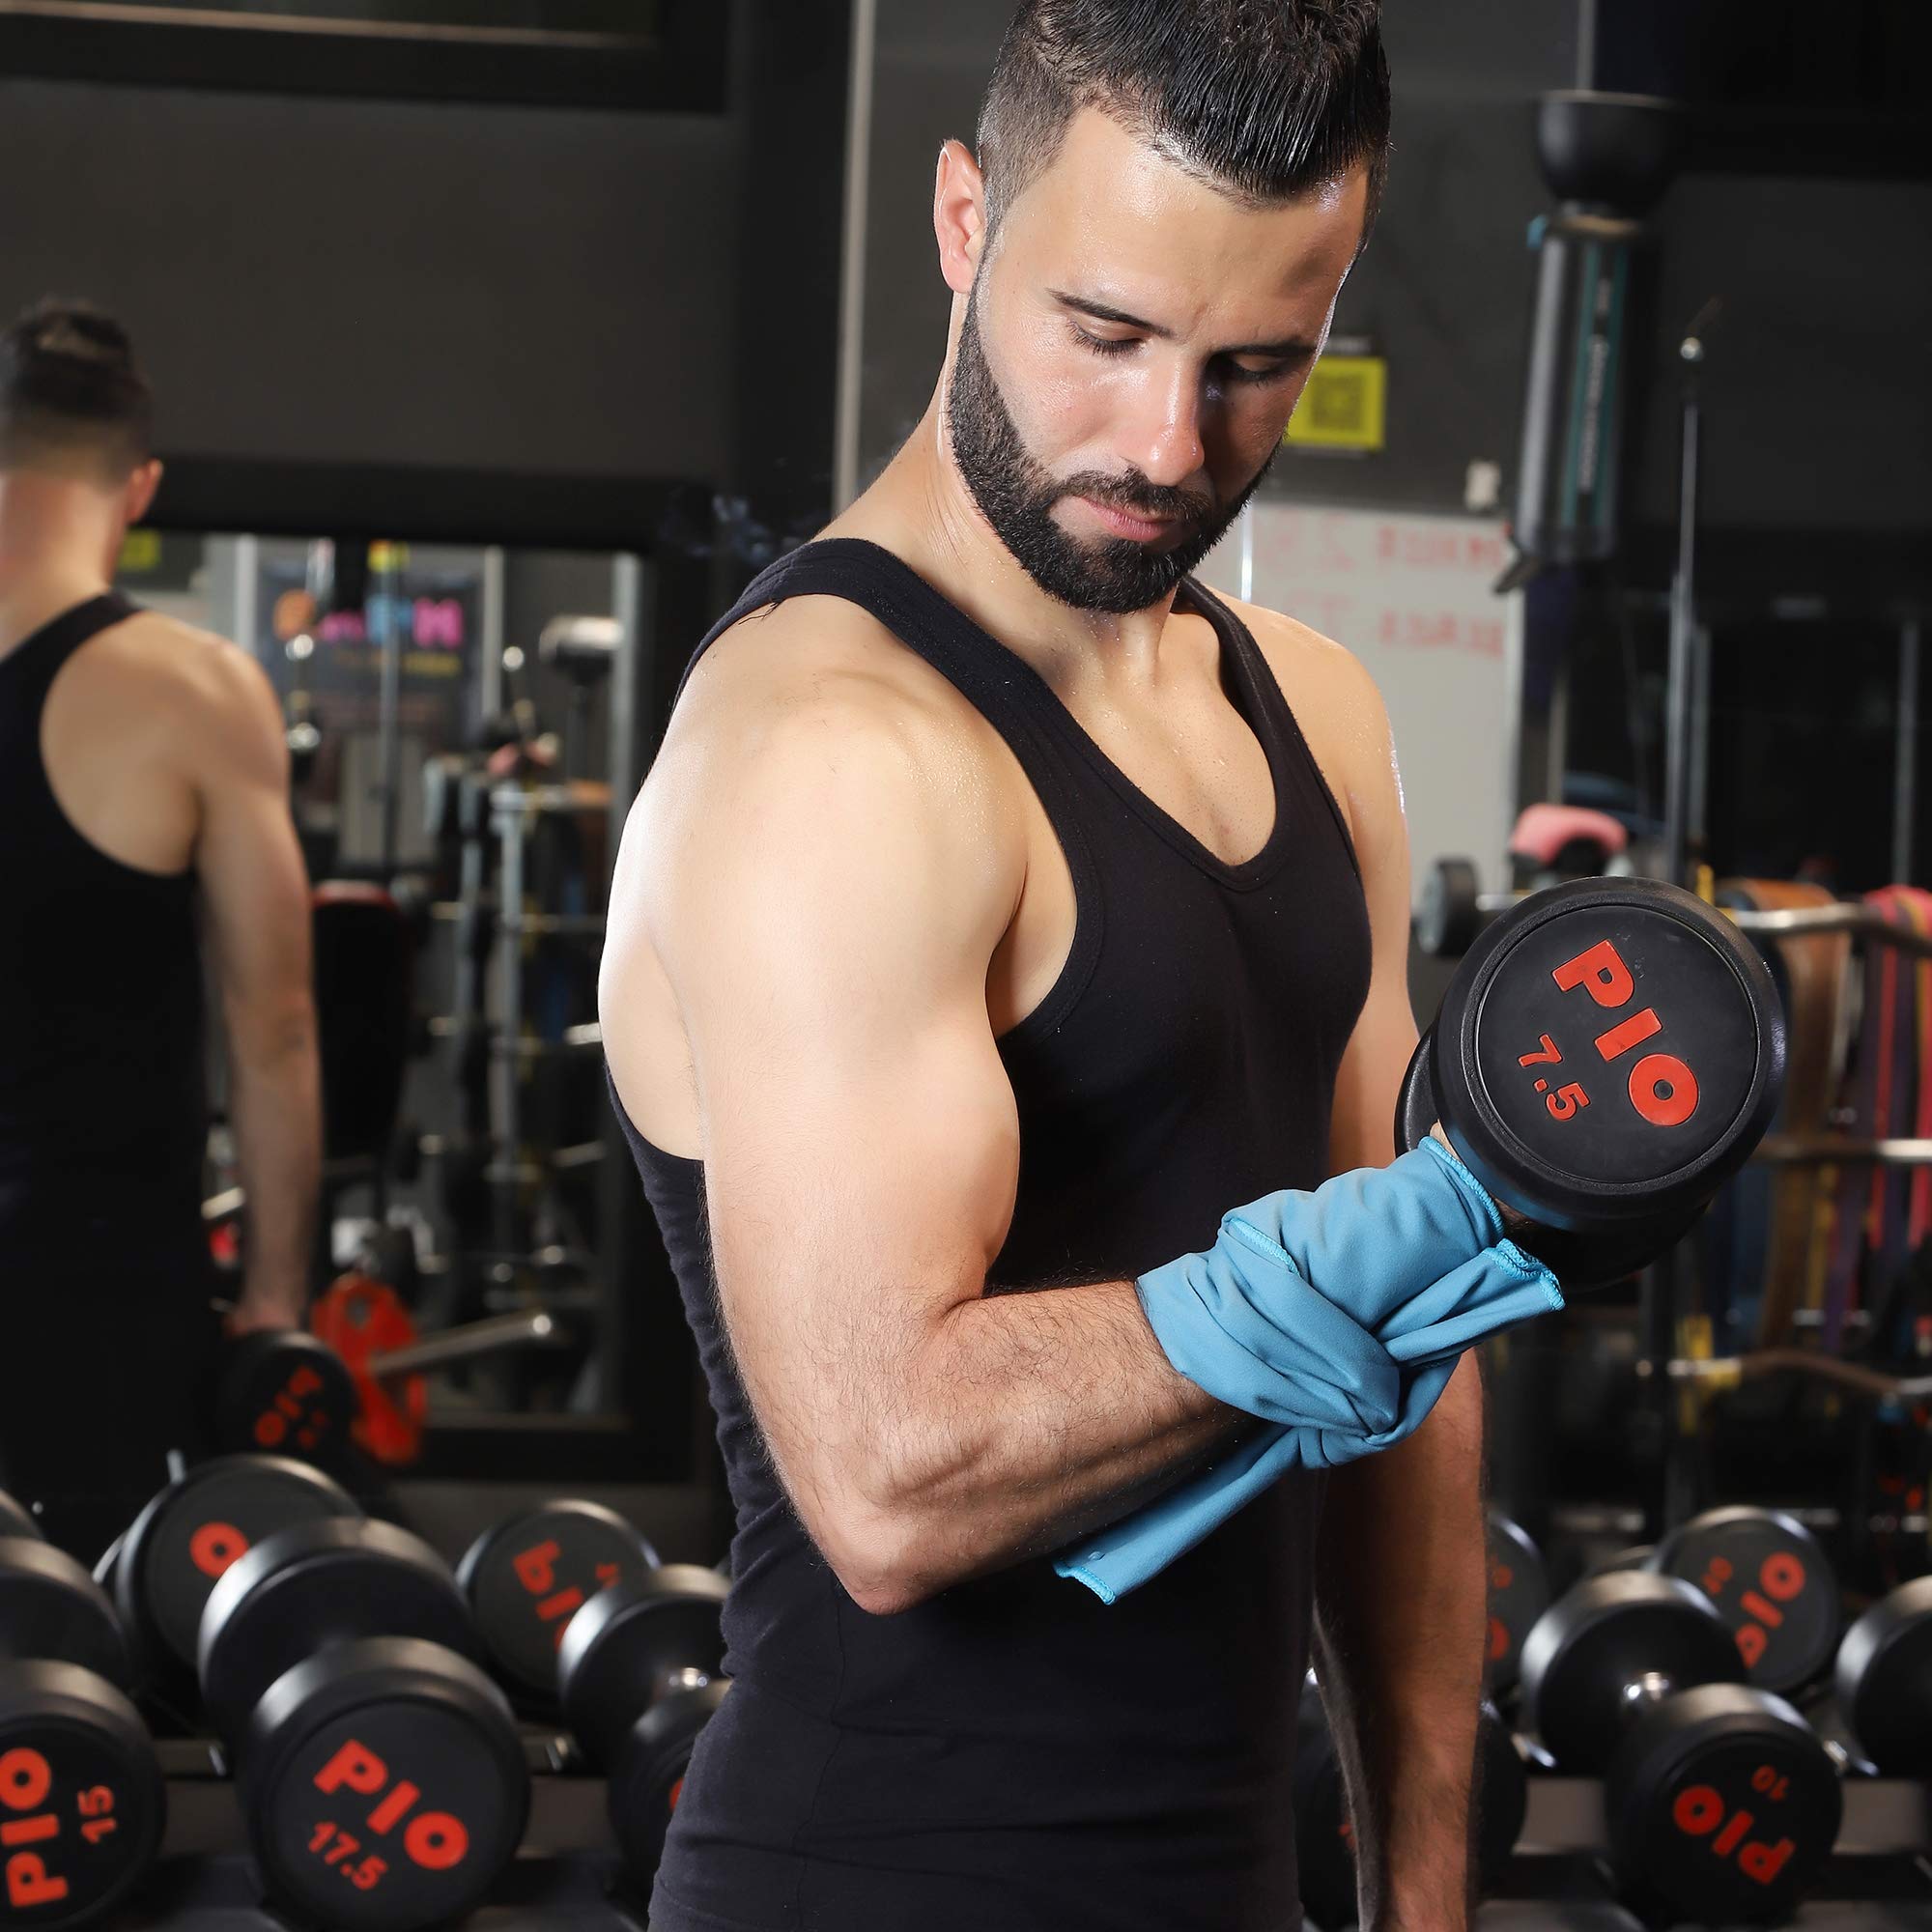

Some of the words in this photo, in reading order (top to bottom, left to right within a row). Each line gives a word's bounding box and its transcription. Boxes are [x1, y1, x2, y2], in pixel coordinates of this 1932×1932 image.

[1518, 1034, 1590, 1122] 7.5
[1551, 939, 1700, 1127] PIO
[0, 1747, 69, 1907] PIO
[77, 1785, 116, 1843] 15
[314, 1739, 469, 1870] PIO
[1752, 1766, 1788, 1801] 10
[308, 1822, 388, 1890] 17.5
[1674, 1786, 1795, 1884] PIO
